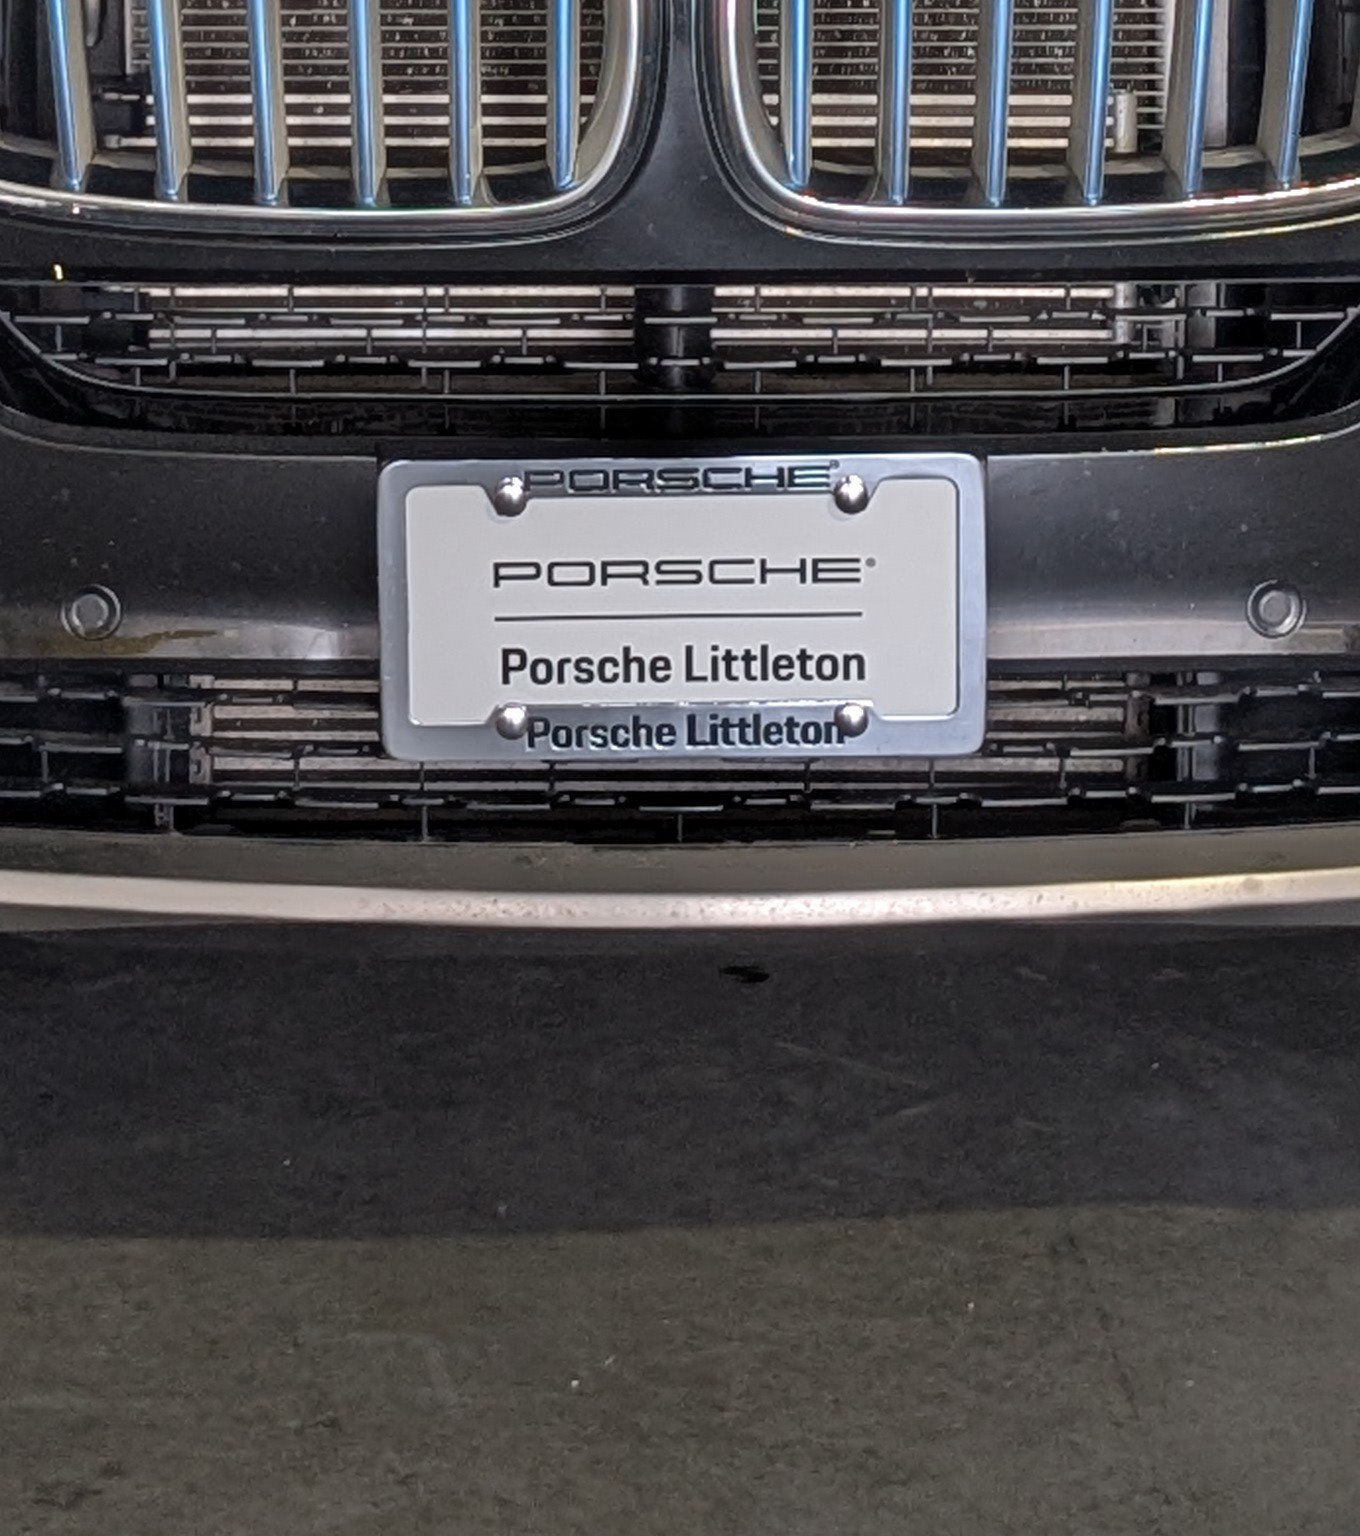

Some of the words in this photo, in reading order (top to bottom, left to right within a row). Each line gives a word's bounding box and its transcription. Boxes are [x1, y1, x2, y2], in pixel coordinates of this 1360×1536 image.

[522, 465, 831, 493] PORSCHE
[492, 557, 862, 588] PORSCHE
[501, 646, 672, 685] Porsche
[684, 644, 867, 683] Littleton
[526, 713, 677, 749] Porsche
[686, 711, 846, 748] Littleton
